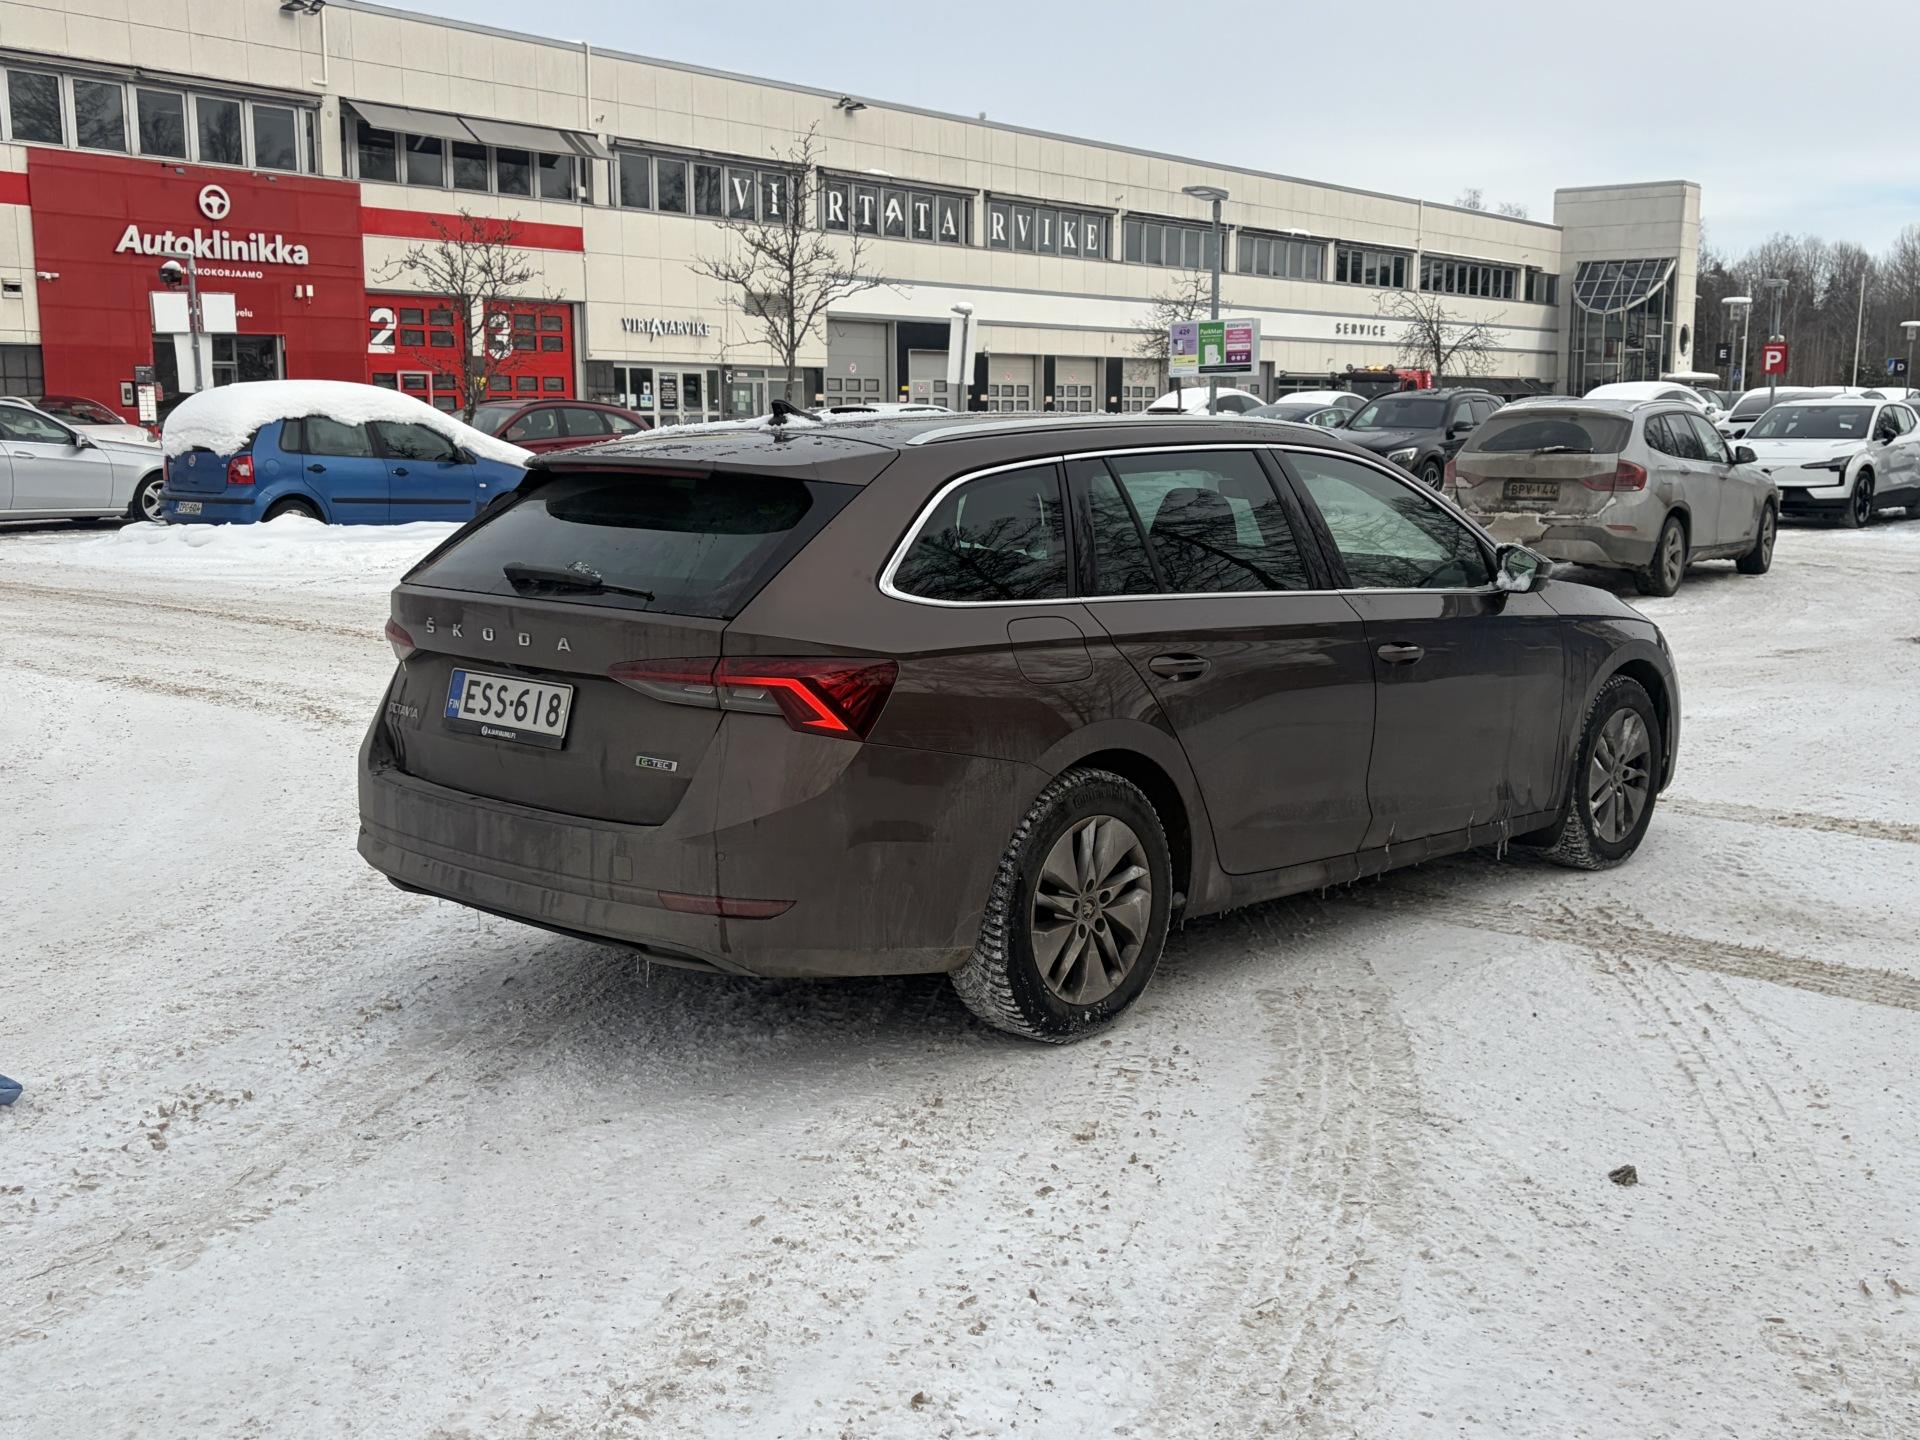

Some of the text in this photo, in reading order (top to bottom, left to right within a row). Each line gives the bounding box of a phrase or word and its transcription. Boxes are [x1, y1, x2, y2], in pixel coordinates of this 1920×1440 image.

[115, 224, 309, 265] Autoklinikka
[367, 307, 398, 354] 2
[621, 317, 711, 342] VIRTATARVIKE
[1335, 322, 1386, 336] SERVICE
[1719, 349, 1728, 359] E
[1765, 350, 1783, 371] P
[1897, 362, 1905, 371] D
[425, 616, 572, 652] ŠKODA
[388, 701, 418, 719] OCTAVIA
[448, 698, 460, 710] FIN
[463, 679, 562, 728] ESS-618
